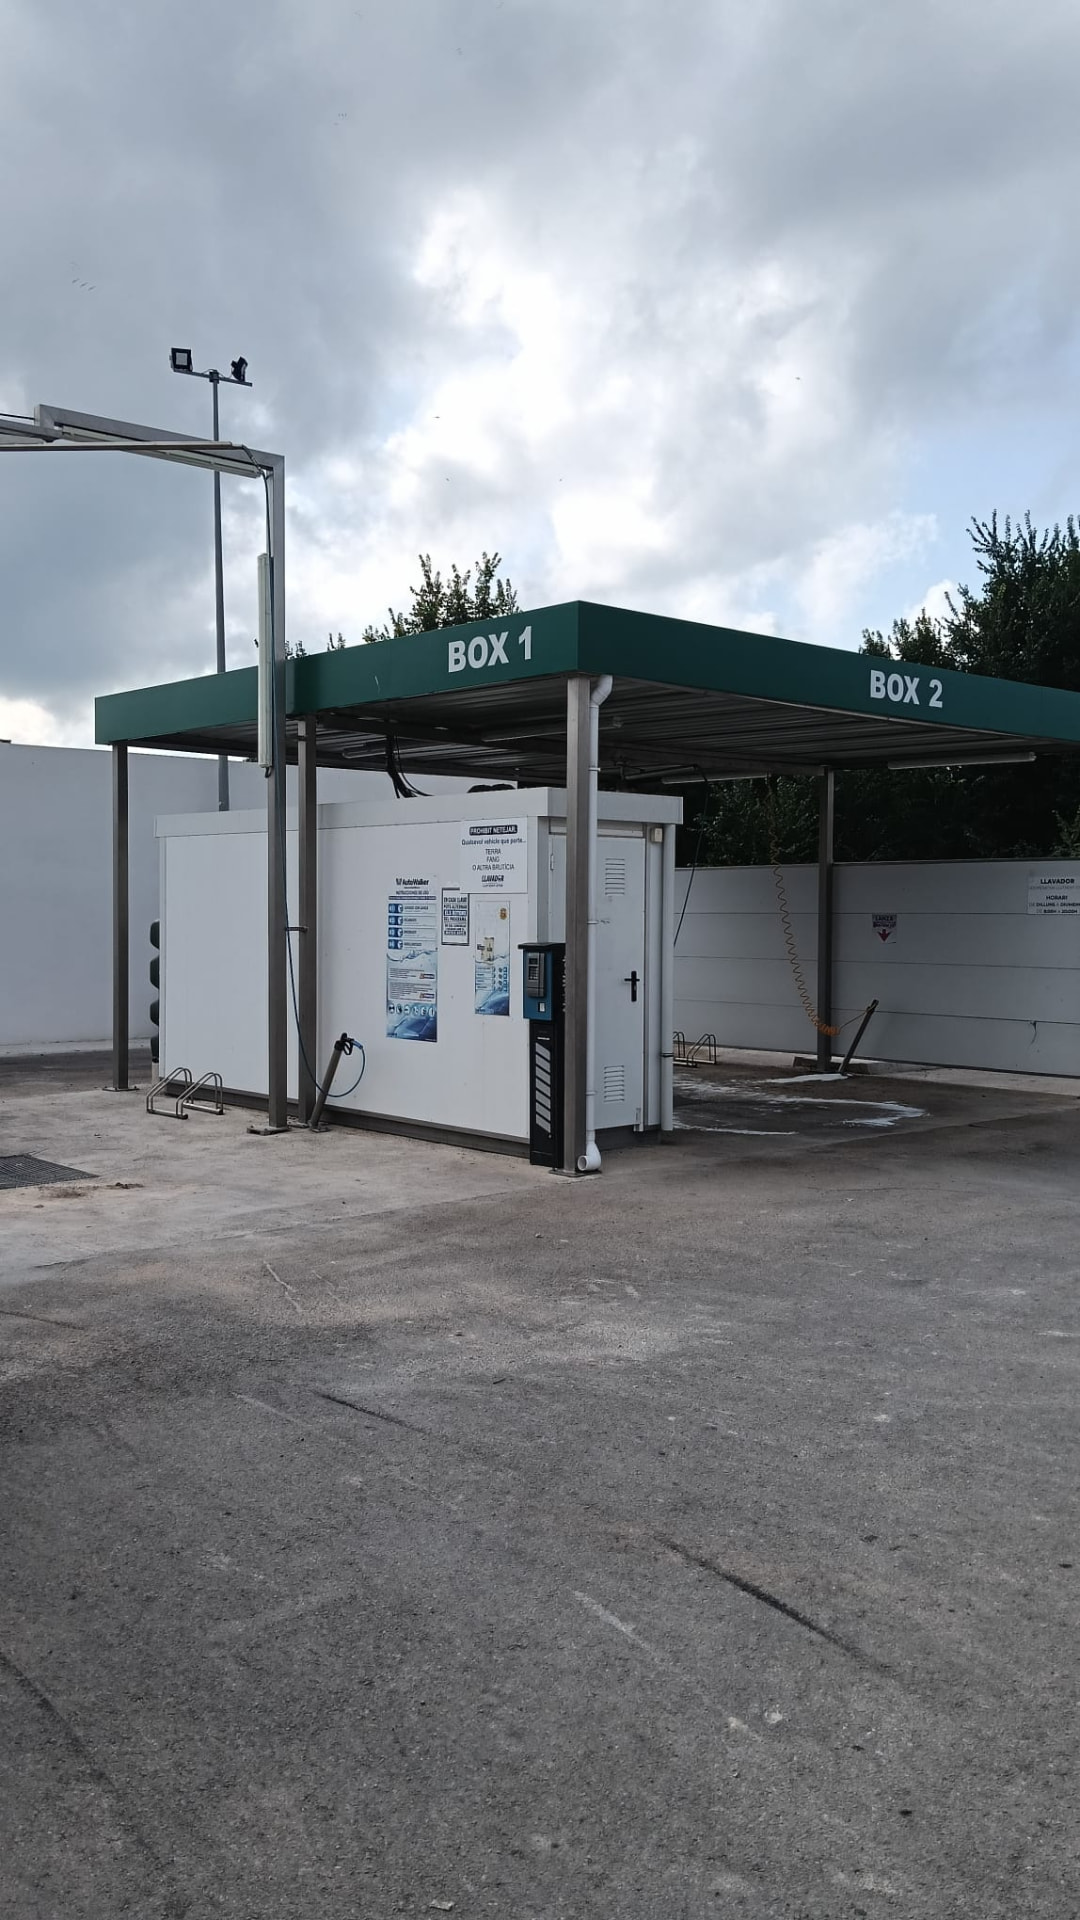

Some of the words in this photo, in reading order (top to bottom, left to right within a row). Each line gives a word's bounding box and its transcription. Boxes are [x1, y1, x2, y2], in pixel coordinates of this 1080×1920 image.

[448, 631, 509, 673] BOX
[518, 625, 532, 660] 1
[870, 669, 920, 705] BOX
[928, 679, 943, 708] 2
[402, 878, 429, 886] AutoWalker
